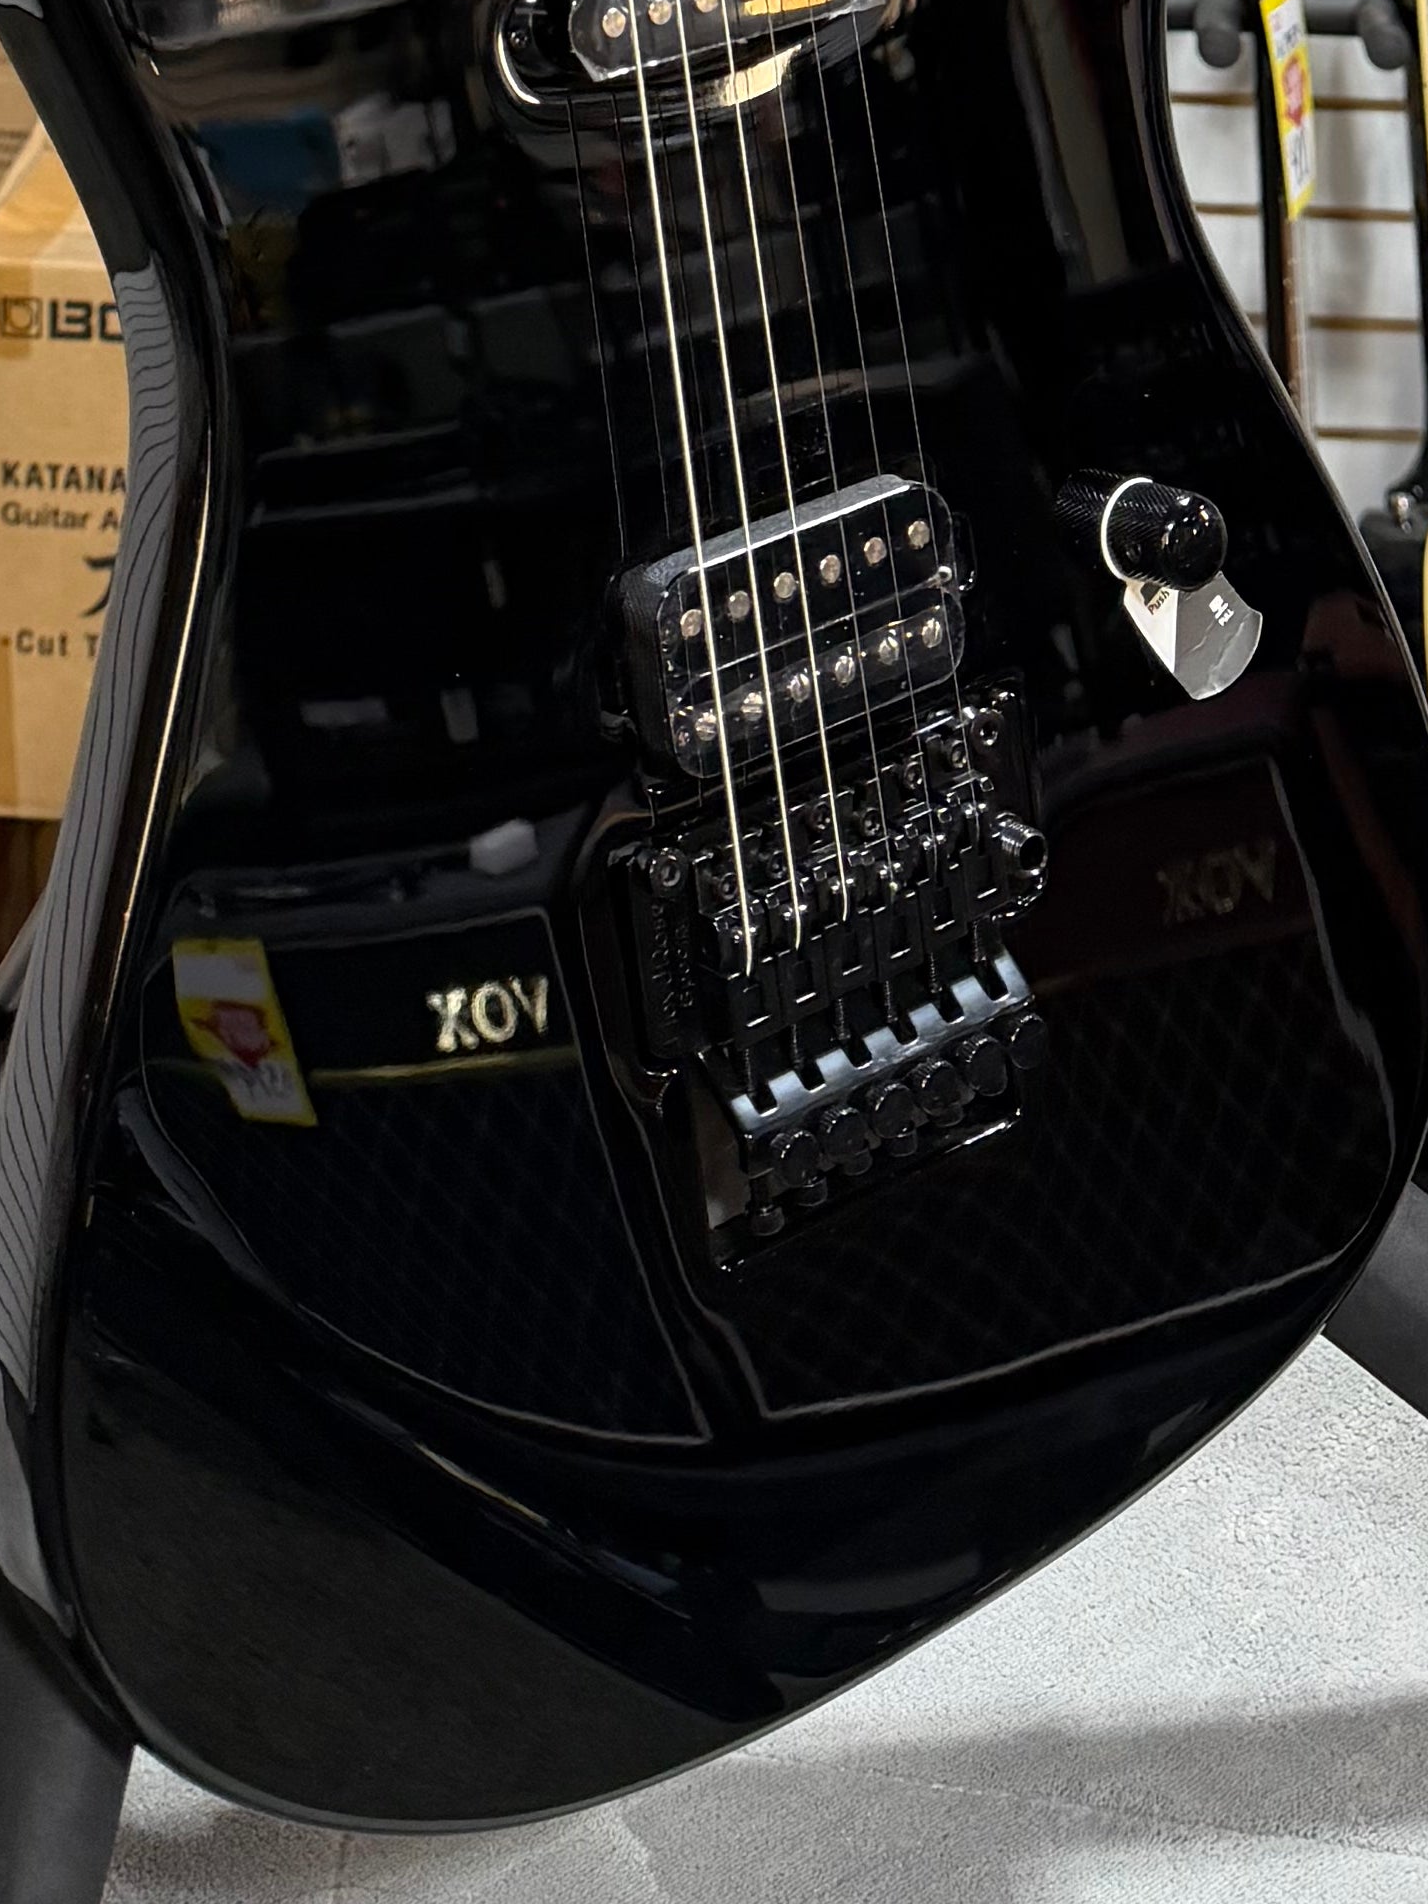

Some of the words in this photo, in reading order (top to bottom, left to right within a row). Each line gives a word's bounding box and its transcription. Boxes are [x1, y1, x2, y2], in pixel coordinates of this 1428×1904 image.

[0, 461, 128, 493] KATANA
[0, 500, 89, 531] Guitar
[1146, 588, 1171, 616] Push
[14, 628, 70, 659] Cut
